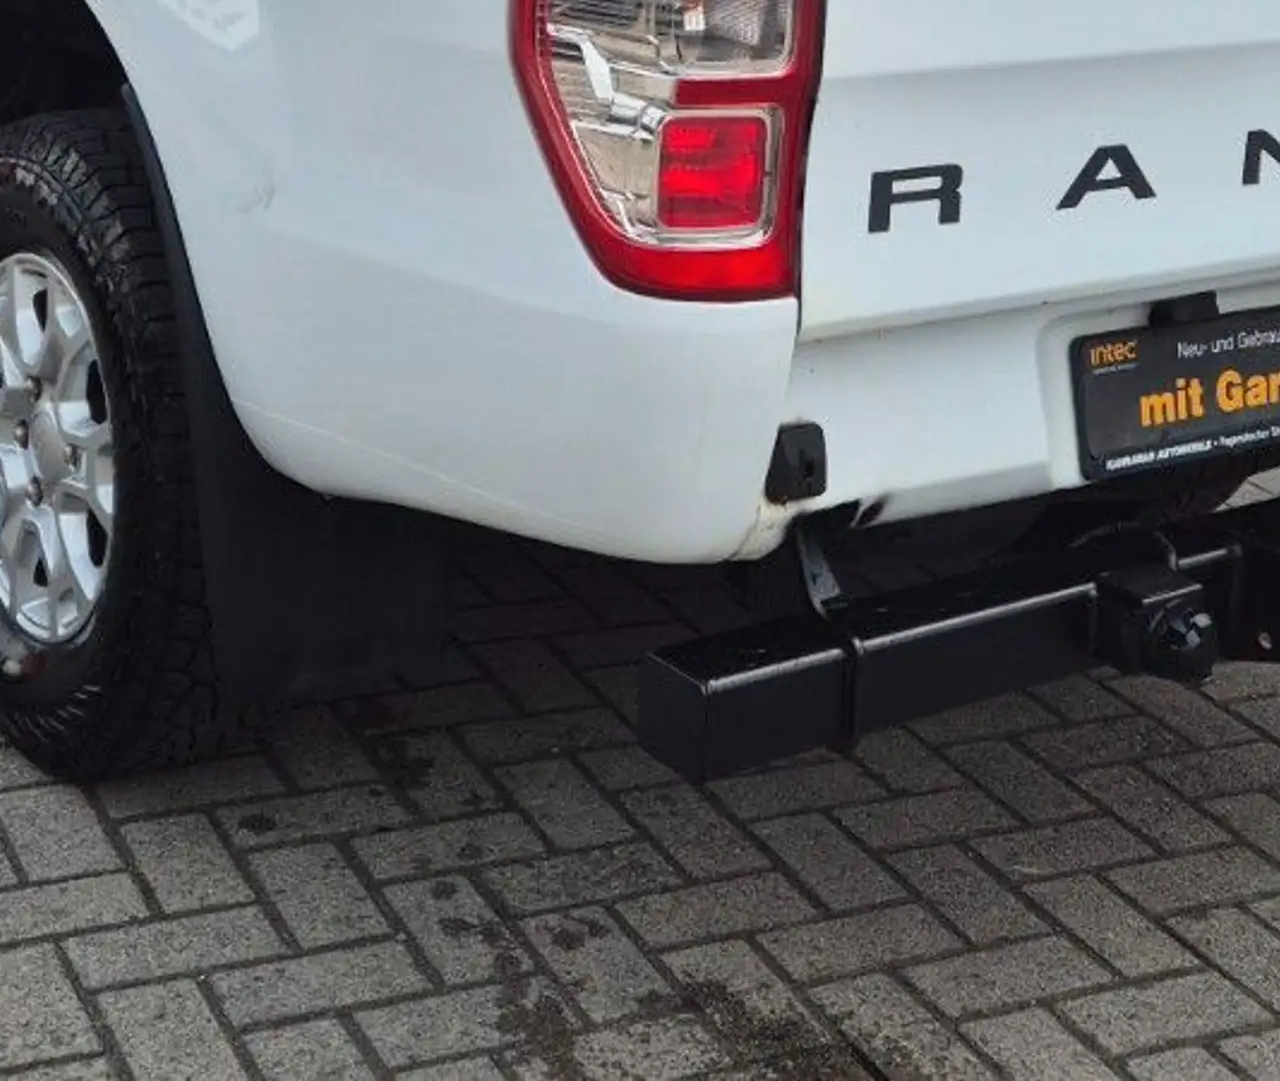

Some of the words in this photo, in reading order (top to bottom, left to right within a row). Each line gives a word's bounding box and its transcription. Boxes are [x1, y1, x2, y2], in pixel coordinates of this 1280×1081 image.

[1088, 340, 1138, 366] intec
[1177, 341, 1208, 359] Neu-
[1211, 334, 1234, 353] und
[1139, 377, 1205, 428] mit
